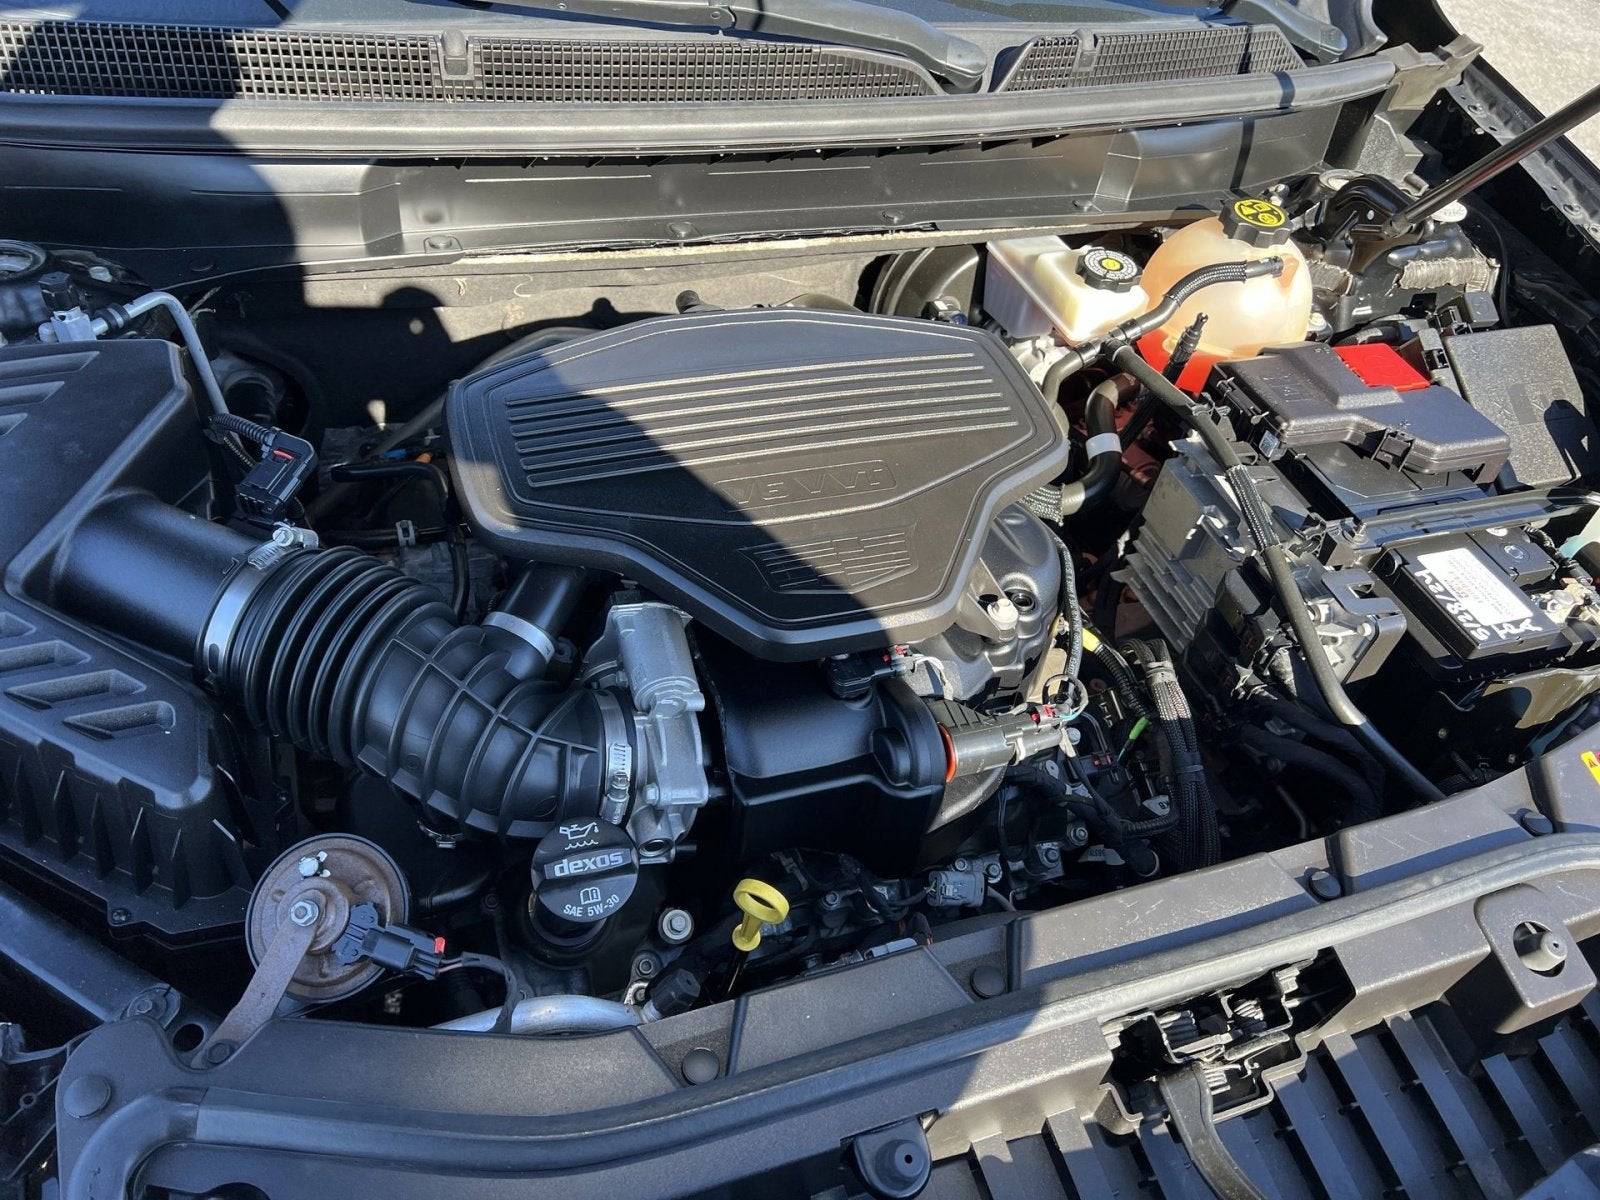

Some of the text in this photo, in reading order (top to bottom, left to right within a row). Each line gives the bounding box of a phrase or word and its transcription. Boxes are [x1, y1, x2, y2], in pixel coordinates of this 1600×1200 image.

[720, 468, 884, 505] V6 VVT
[554, 852, 623, 877] dexos
[563, 894, 620, 917] SAE 5W-30
